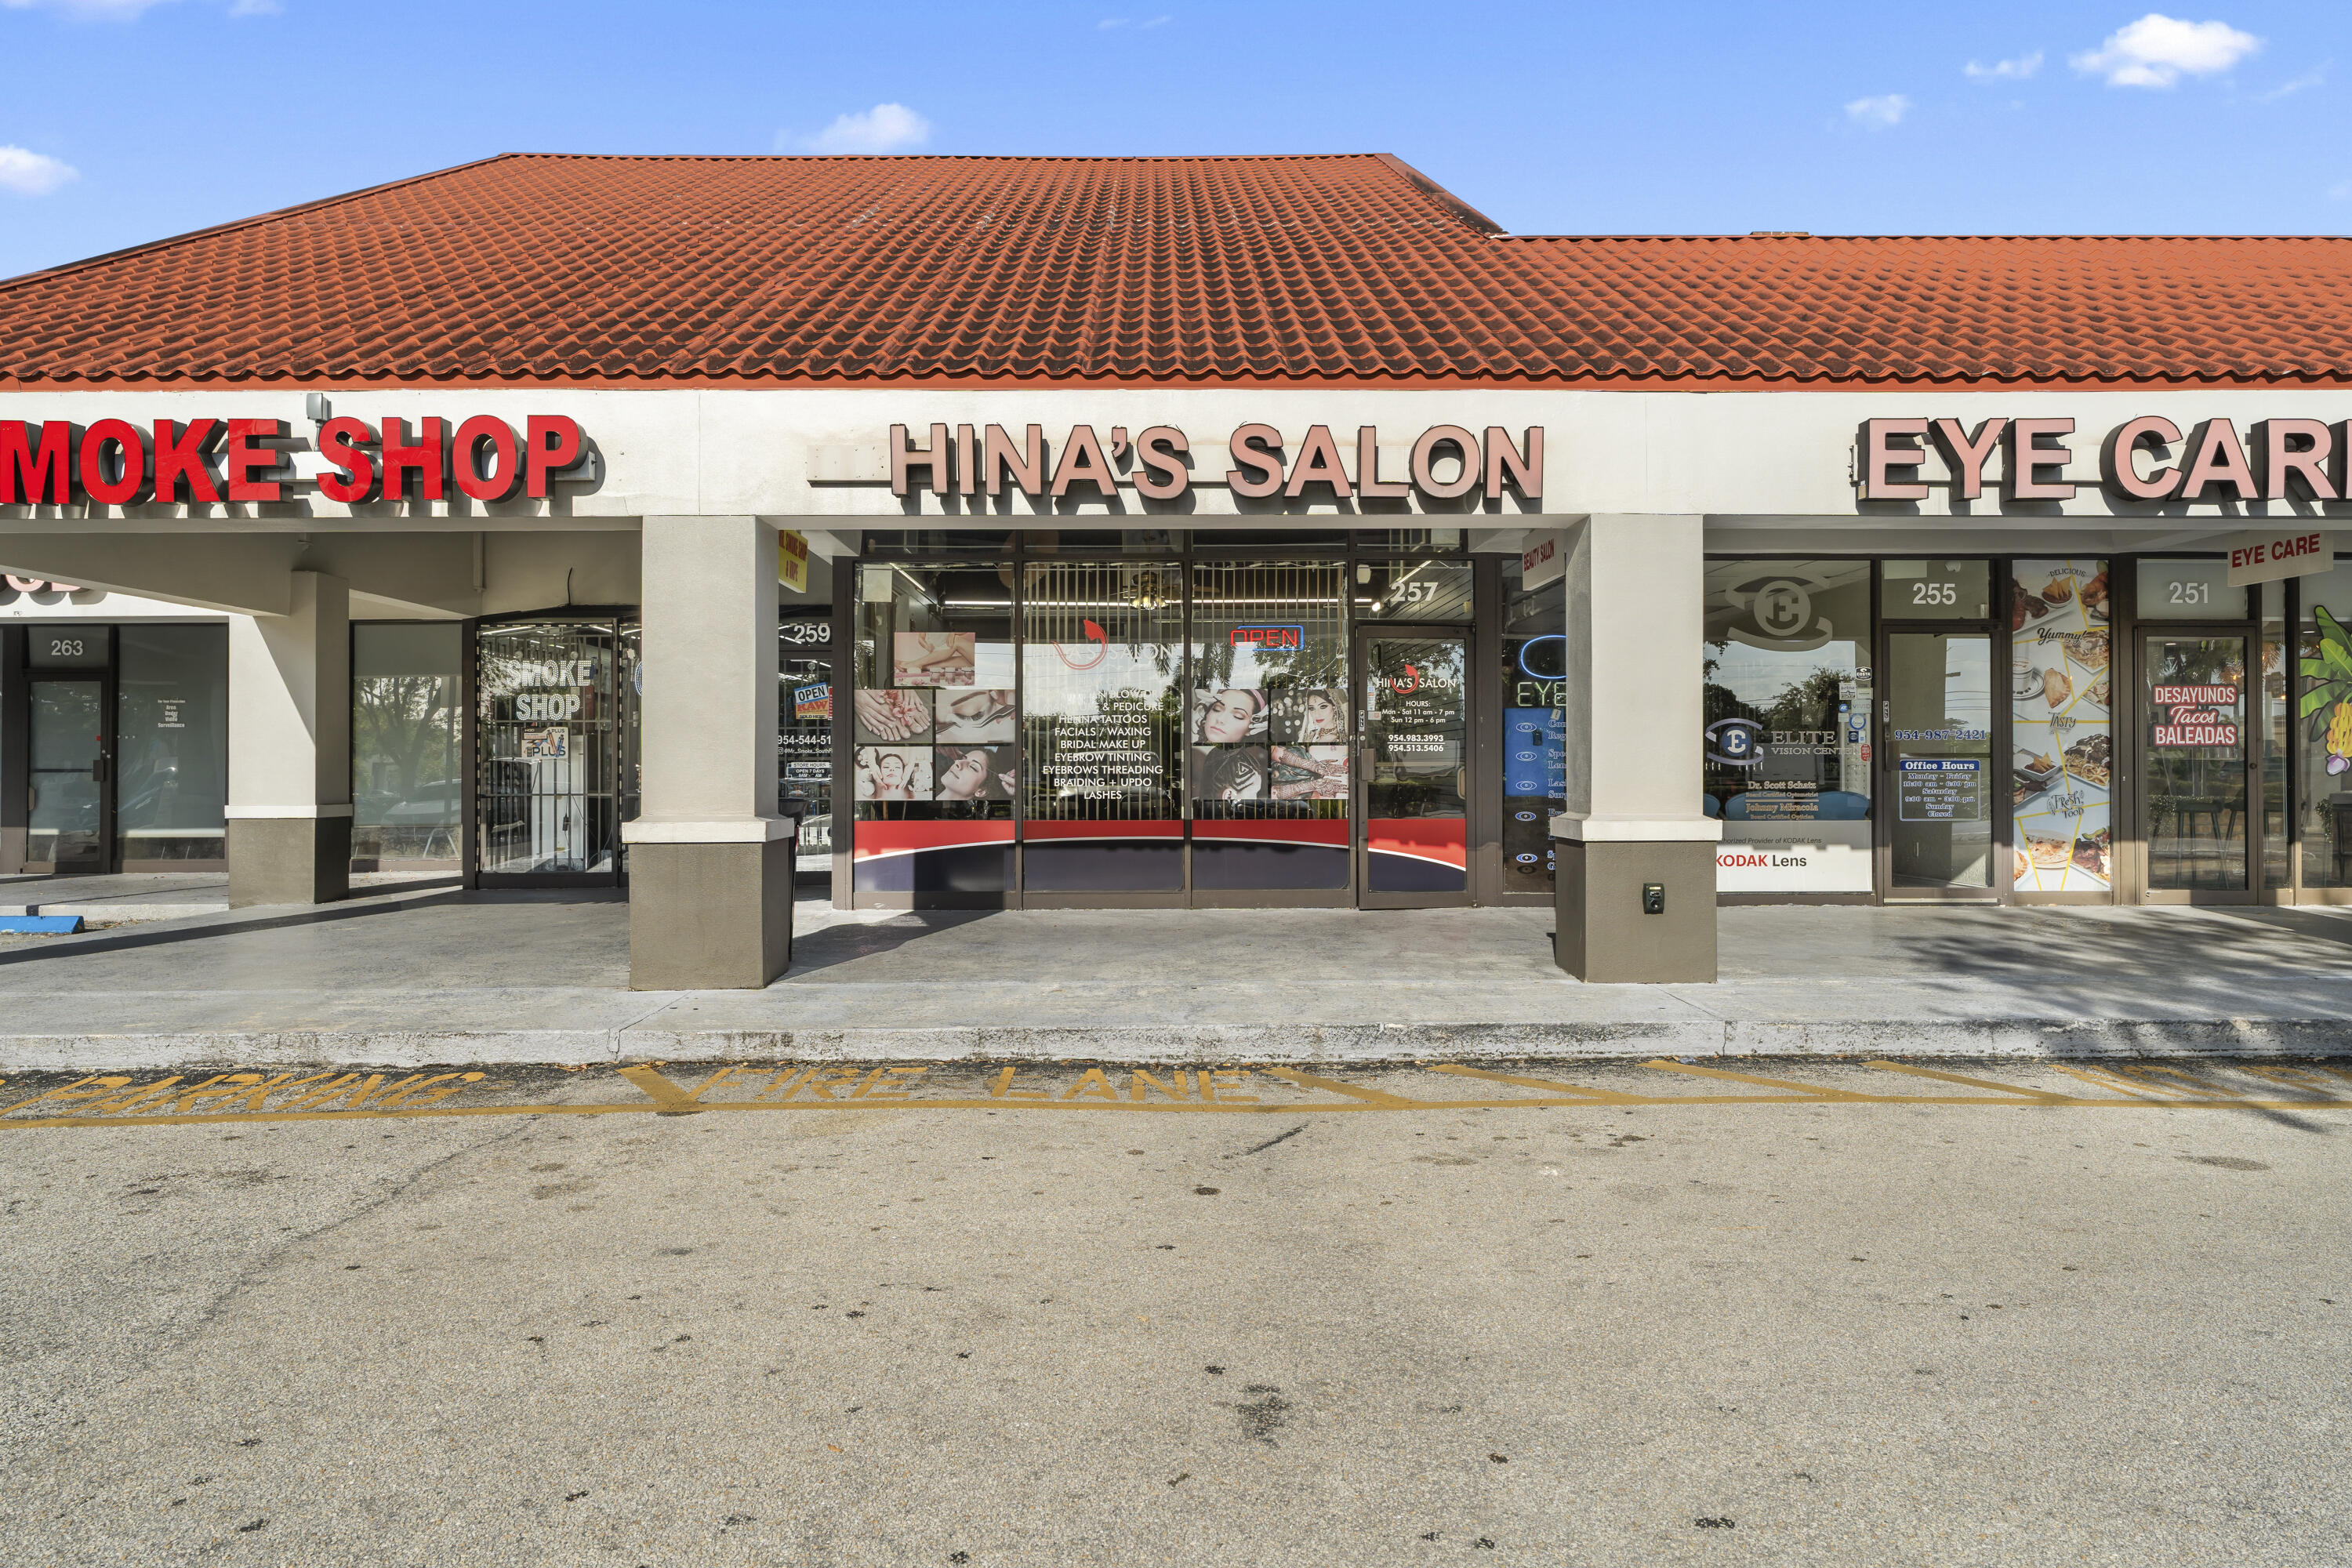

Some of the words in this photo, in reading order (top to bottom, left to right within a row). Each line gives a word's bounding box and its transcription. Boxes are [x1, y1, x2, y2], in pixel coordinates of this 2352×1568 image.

[316, 415, 586, 503] SHOP
[890, 423, 1190, 499] HINA'S
[1225, 423, 1544, 499] SALON
[1860, 416, 2077, 500] EYE
[2107, 415, 2352, 501] CAR
[1523, 546, 1539, 572] BEAUTY
[1541, 538, 1555, 564] SALON
[2231, 545, 2266, 568] EYE
[2270, 533, 2321, 561] CARE
[2049, 568, 2086, 577] DELICIOUS
[1390, 583, 1439, 601] 257
[1913, 583, 1956, 605] 255
[2169, 582, 2209, 604] 251
[793, 625, 831, 643] 259
[1230, 630, 1298, 647] OPEN
[2037, 627, 2087, 647] Yummy!
[51, 640, 83, 656] 263
[506, 659, 592, 687] SMOKE
[1418, 678, 1457, 688] SALON
[798, 685, 826, 702] OPEN
[2155, 687, 2235, 703] DESAYUNOS
[516, 693, 581, 720] SHOP
[797, 700, 828, 712] RAW
[1102, 702, 1110, 711] &
[1113, 702, 1164, 711] PEDICURE
[1058, 715, 1098, 724] HENNA
[1100, 714, 1148, 724] TATTOOS
[2170, 706, 2217, 724] Tacos
[1054, 727, 1096, 736] FACIALS
[1106, 727, 1152, 736] WAXING
[1771, 731, 1836, 745] ELITE
[1895, 730, 1987, 741] 954-987-2421
[2155, 726, 2236, 745] BALEADAS
[1061, 739, 1097, 749] BRIDAL
[1099, 739, 1128, 749] MAKE
[1131, 739, 1146, 749] UP
[1054, 753, 1105, 762] EYEBROW
[1108, 753, 1152, 762] TINTING
[1905, 761, 1938, 770] Office
[1941, 761, 1975, 770] Hours
[1043, 765, 1098, 775] EYEBROWS
[1102, 765, 1163, 775] THREADING
[1054, 778, 1105, 787] BRAIDING
[1121, 778, 1152, 787] UPDO
[1748, 781, 1762, 789] Dr.
[1763, 781, 1786, 789] Scott
[1788, 781, 1817, 789] Schatz
[1083, 790, 1122, 800] LASHES
[1746, 803, 1778, 813] Johnny
[1780, 803, 1819, 811] Miracola
[1716, 855, 1768, 866] KODAK
[1772, 855, 1807, 866] Lens
[687, 1067, 928, 1099] FIRE
[990, 1066, 1261, 1102] LANE
